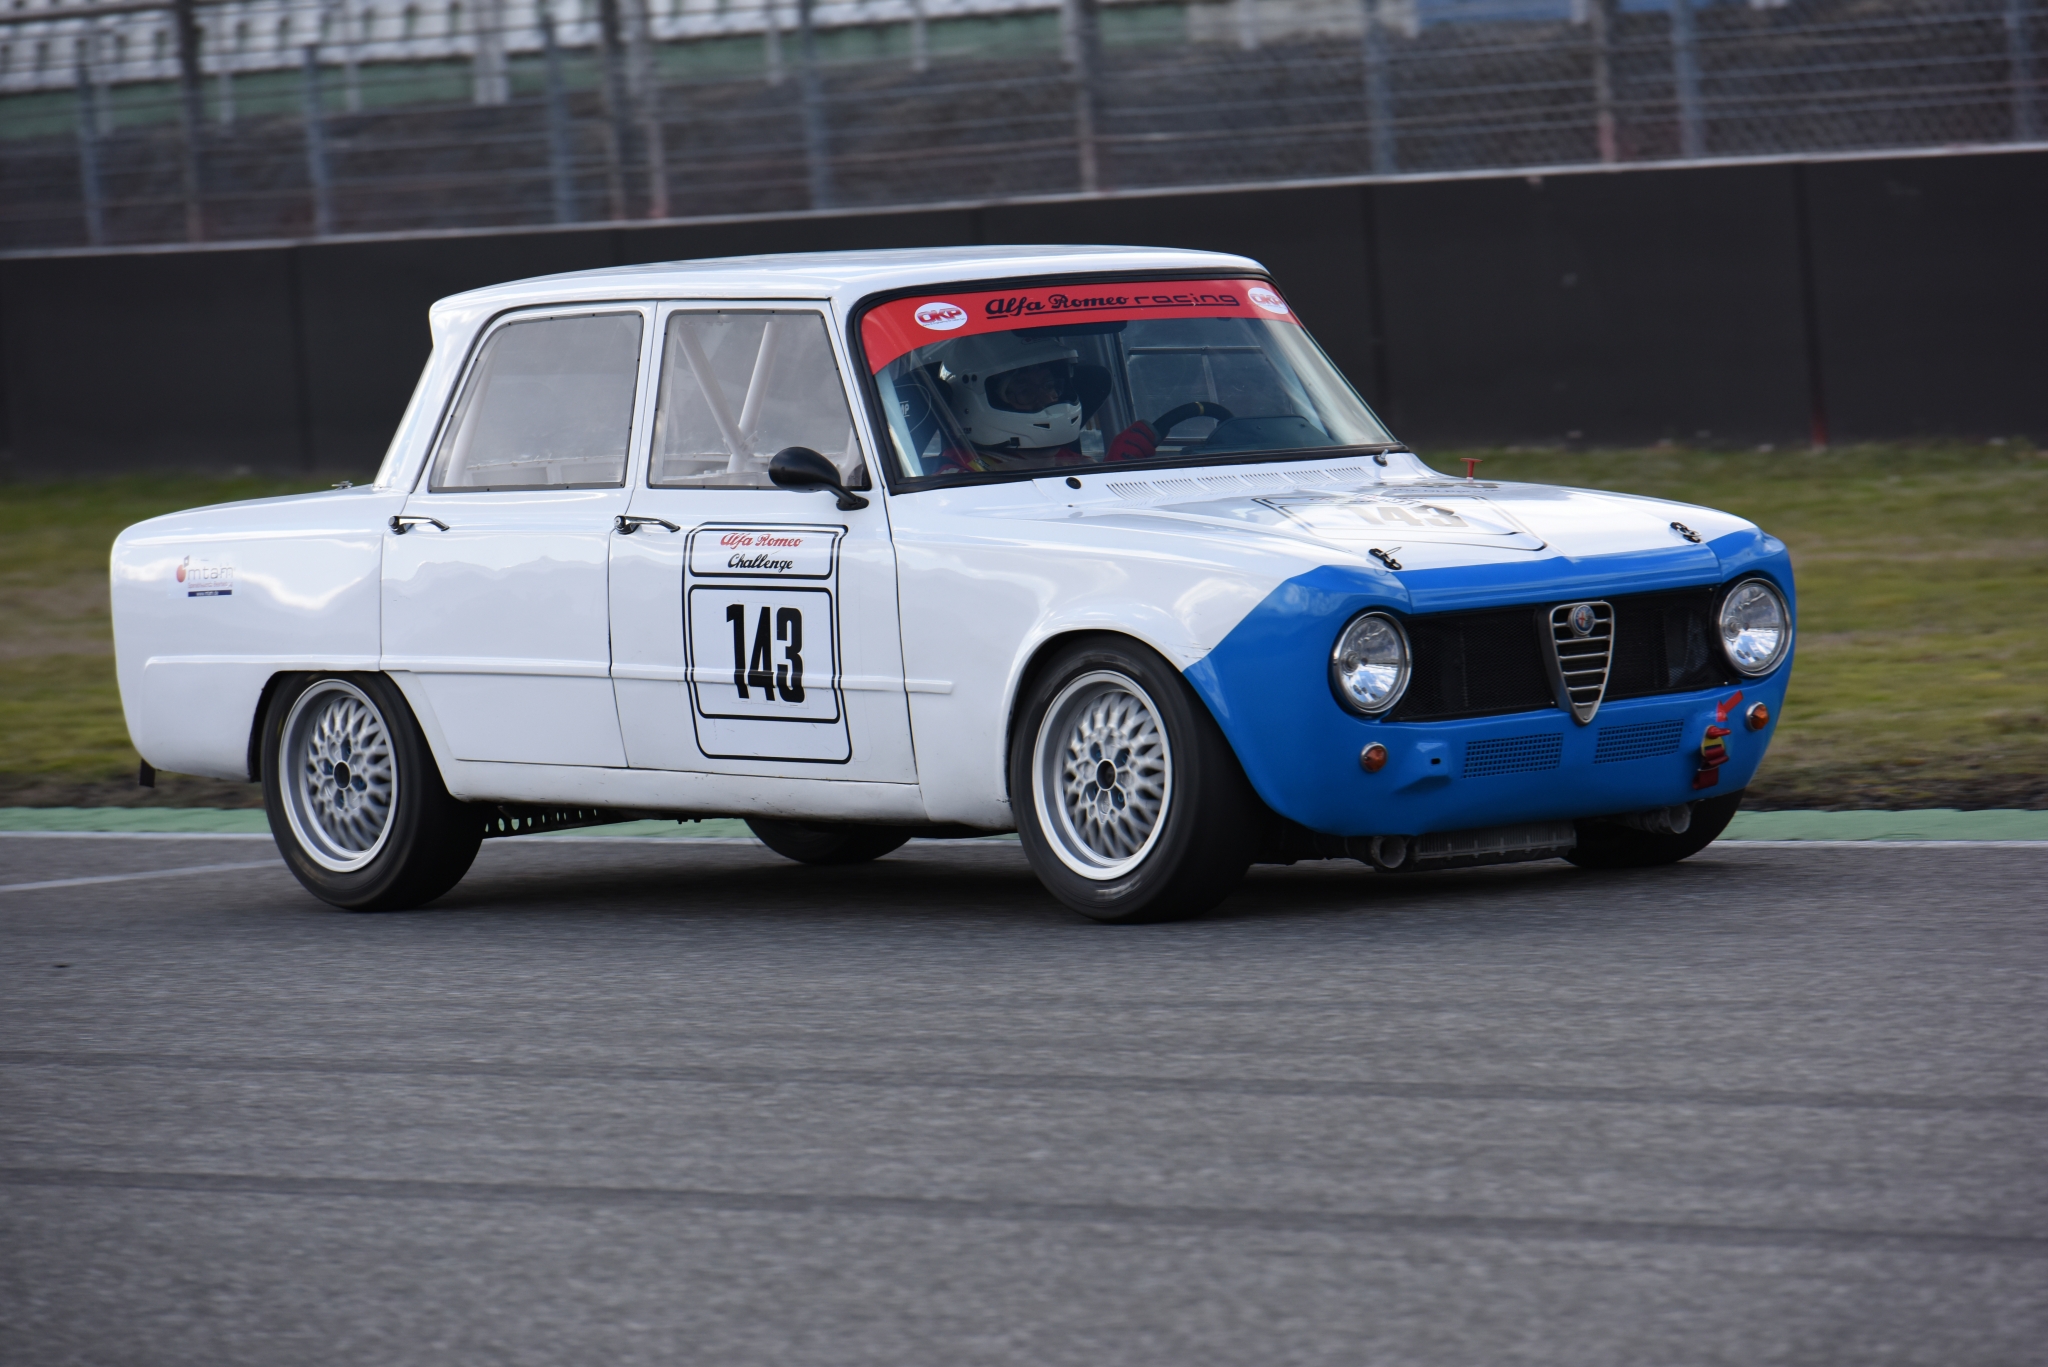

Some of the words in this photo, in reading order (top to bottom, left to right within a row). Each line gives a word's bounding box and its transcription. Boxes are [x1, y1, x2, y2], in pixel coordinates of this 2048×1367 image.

[917, 307, 962, 323] OKP
[985, 297, 1045, 317] Alfa
[1048, 293, 1129, 310] Romeo
[1134, 293, 1241, 307] racing
[1350, 504, 1468, 528] 143
[720, 532, 754, 550] Alfa
[754, 533, 803, 547] Romeo
[727, 553, 793, 573] Challenge
[726, 603, 806, 704] 143
